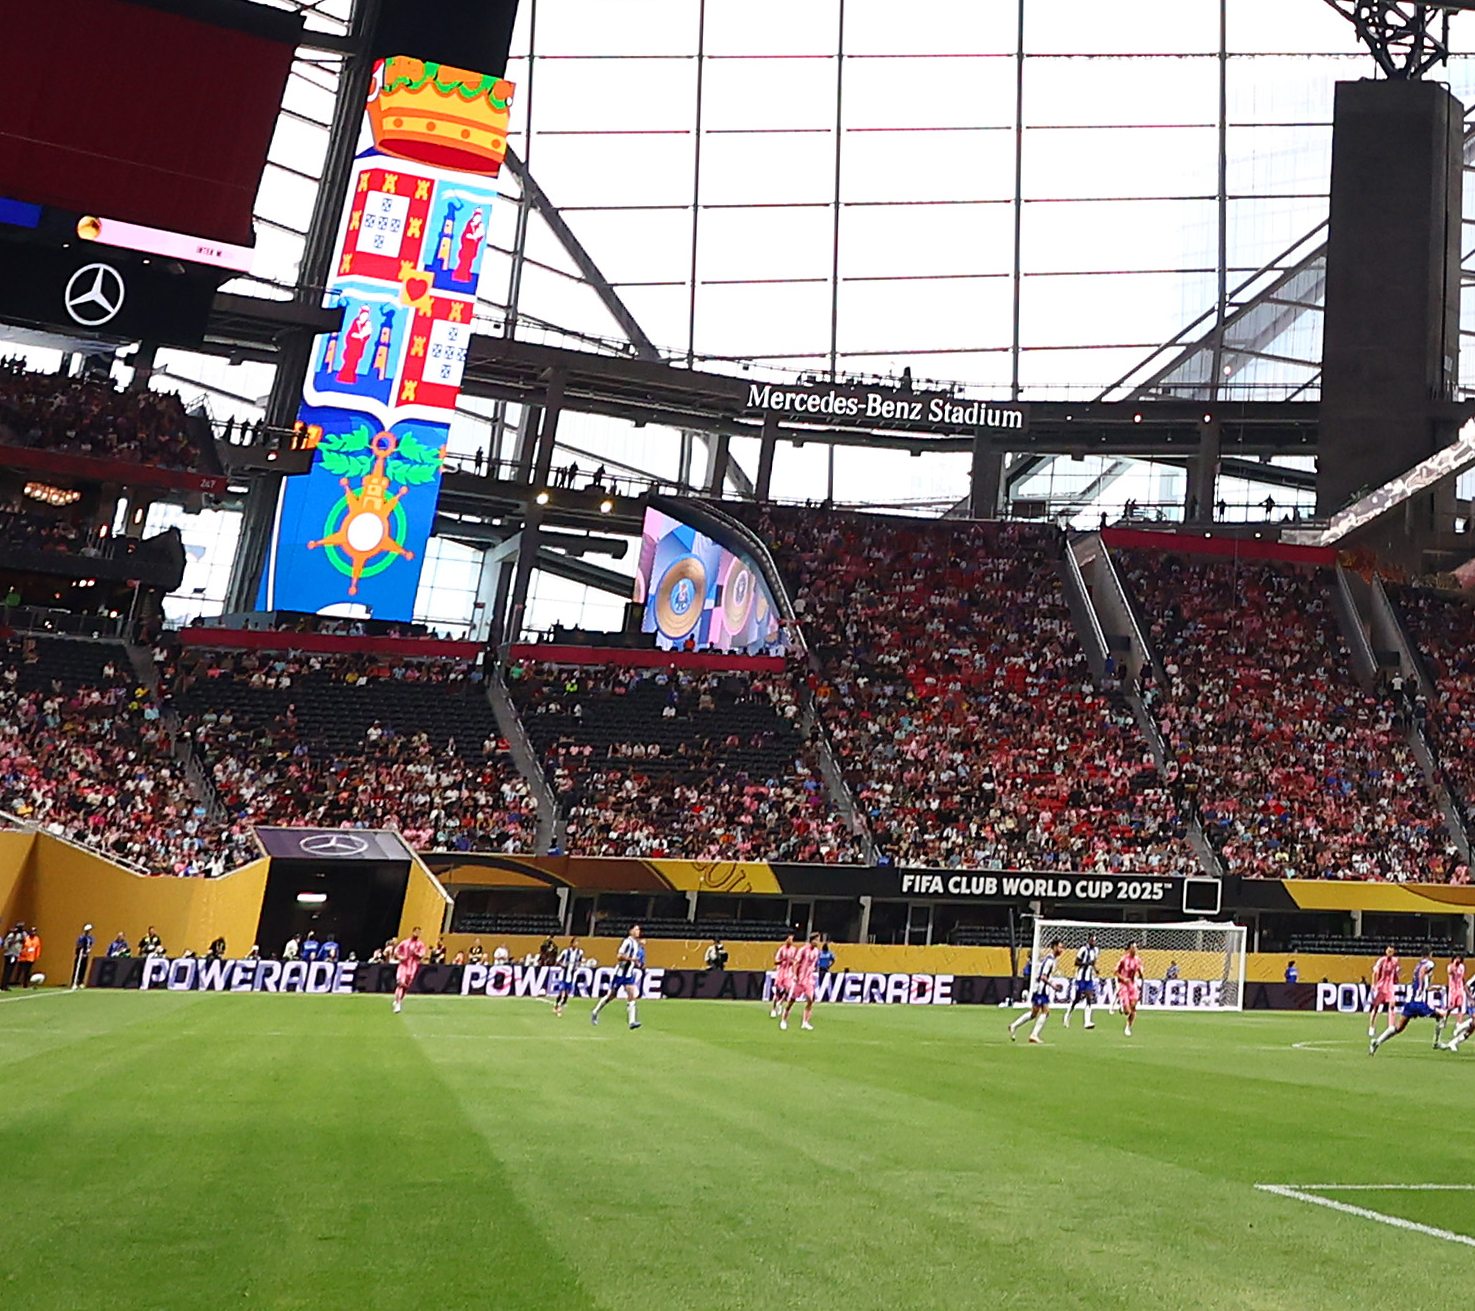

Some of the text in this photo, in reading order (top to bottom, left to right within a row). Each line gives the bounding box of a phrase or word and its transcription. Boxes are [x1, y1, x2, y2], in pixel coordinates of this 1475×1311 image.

[746, 384, 1023, 428] Mercedes-Benz Stadium
[902, 874, 944, 894] FIFA
[947, 875, 997, 896] CLUB
[1002, 877, 1071, 898] WORLD
[1075, 879, 1114, 899] CUP
[140, 958, 357, 994] POWERADE
